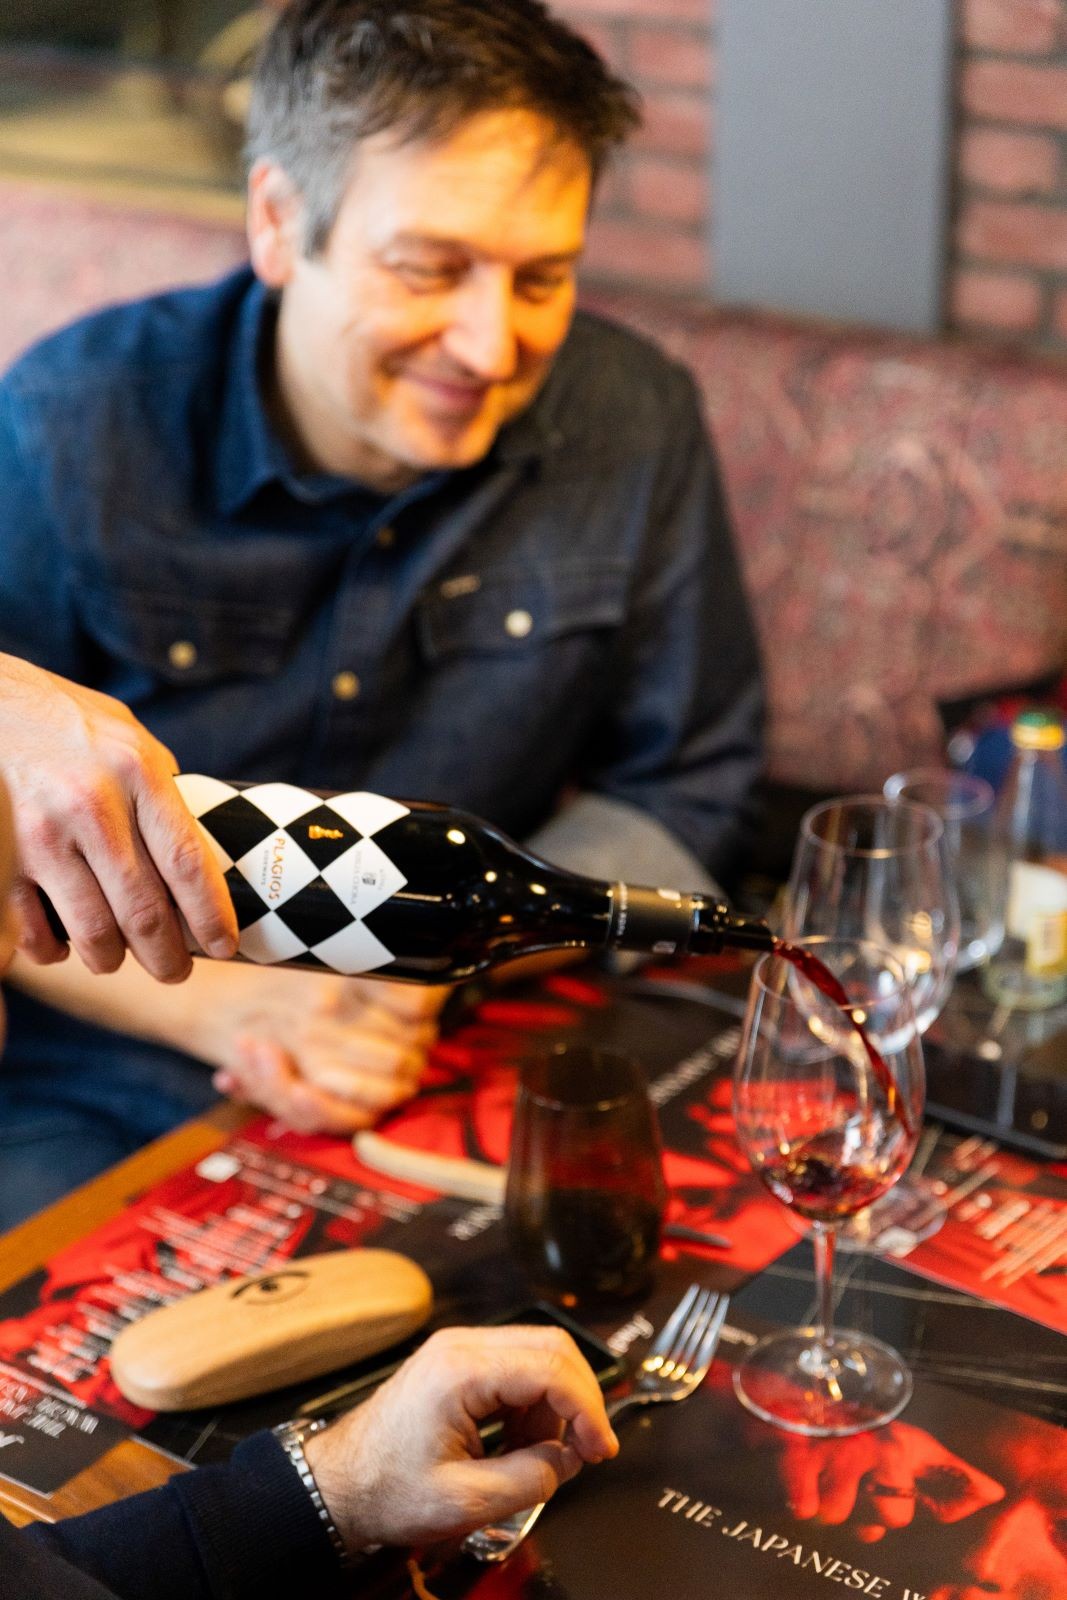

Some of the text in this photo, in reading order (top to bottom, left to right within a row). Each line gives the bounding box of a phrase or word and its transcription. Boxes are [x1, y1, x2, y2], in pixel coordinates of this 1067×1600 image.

[268, 837, 286, 900] PLAGIOS
[657, 1487, 722, 1528] THE
[722, 1520, 891, 1598] JAPANESE
